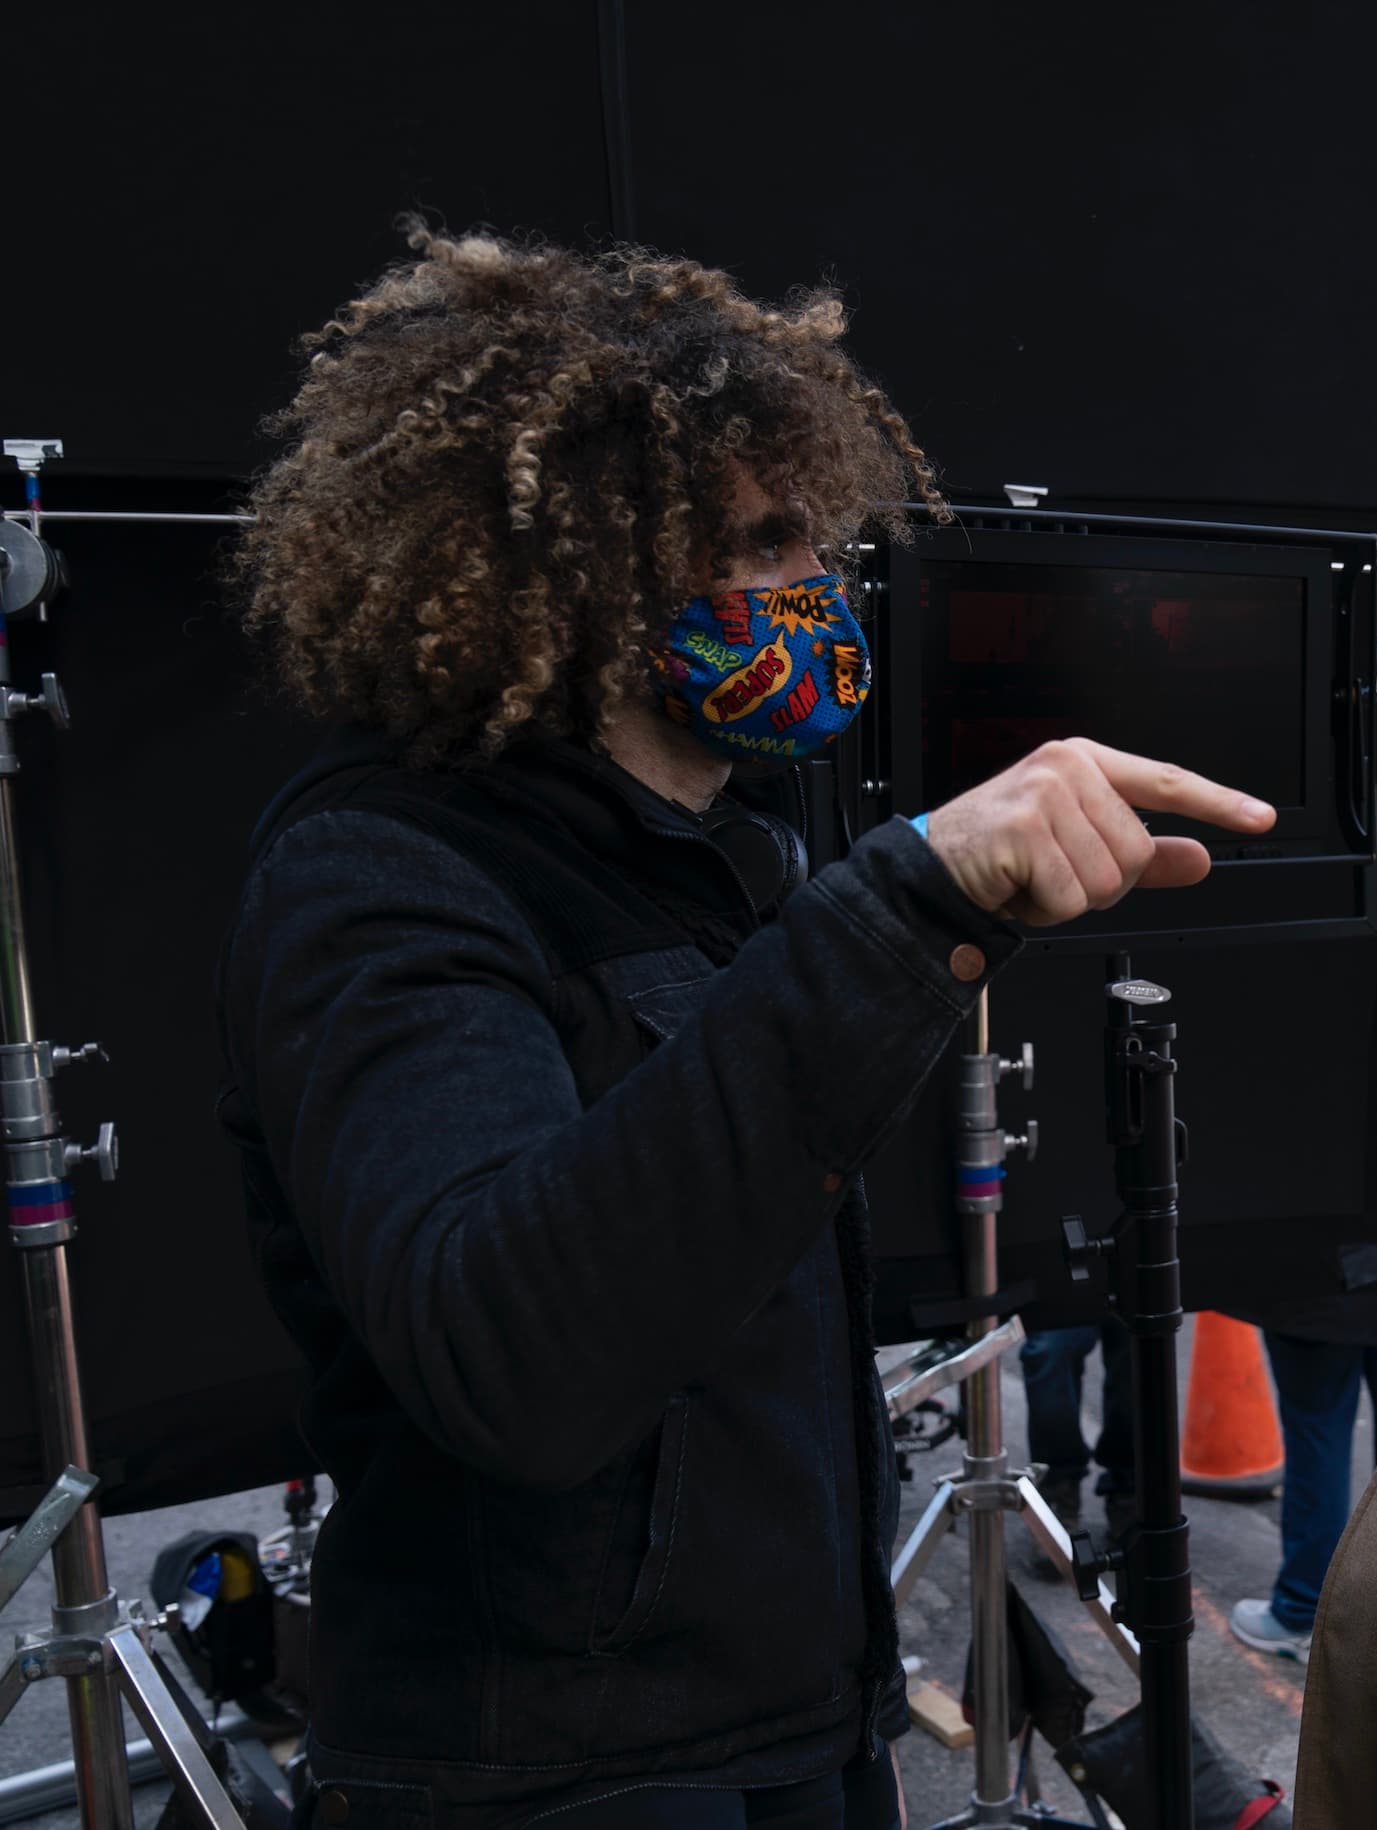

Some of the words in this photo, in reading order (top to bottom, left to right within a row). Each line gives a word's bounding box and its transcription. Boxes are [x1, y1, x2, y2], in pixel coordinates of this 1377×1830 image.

[763, 591, 826, 623] POW!!
[684, 631, 742, 672] SNAP
[834, 643, 860, 706] ZOOM
[710, 647, 785, 722] SUPER!
[770, 668, 820, 733] SLAM
